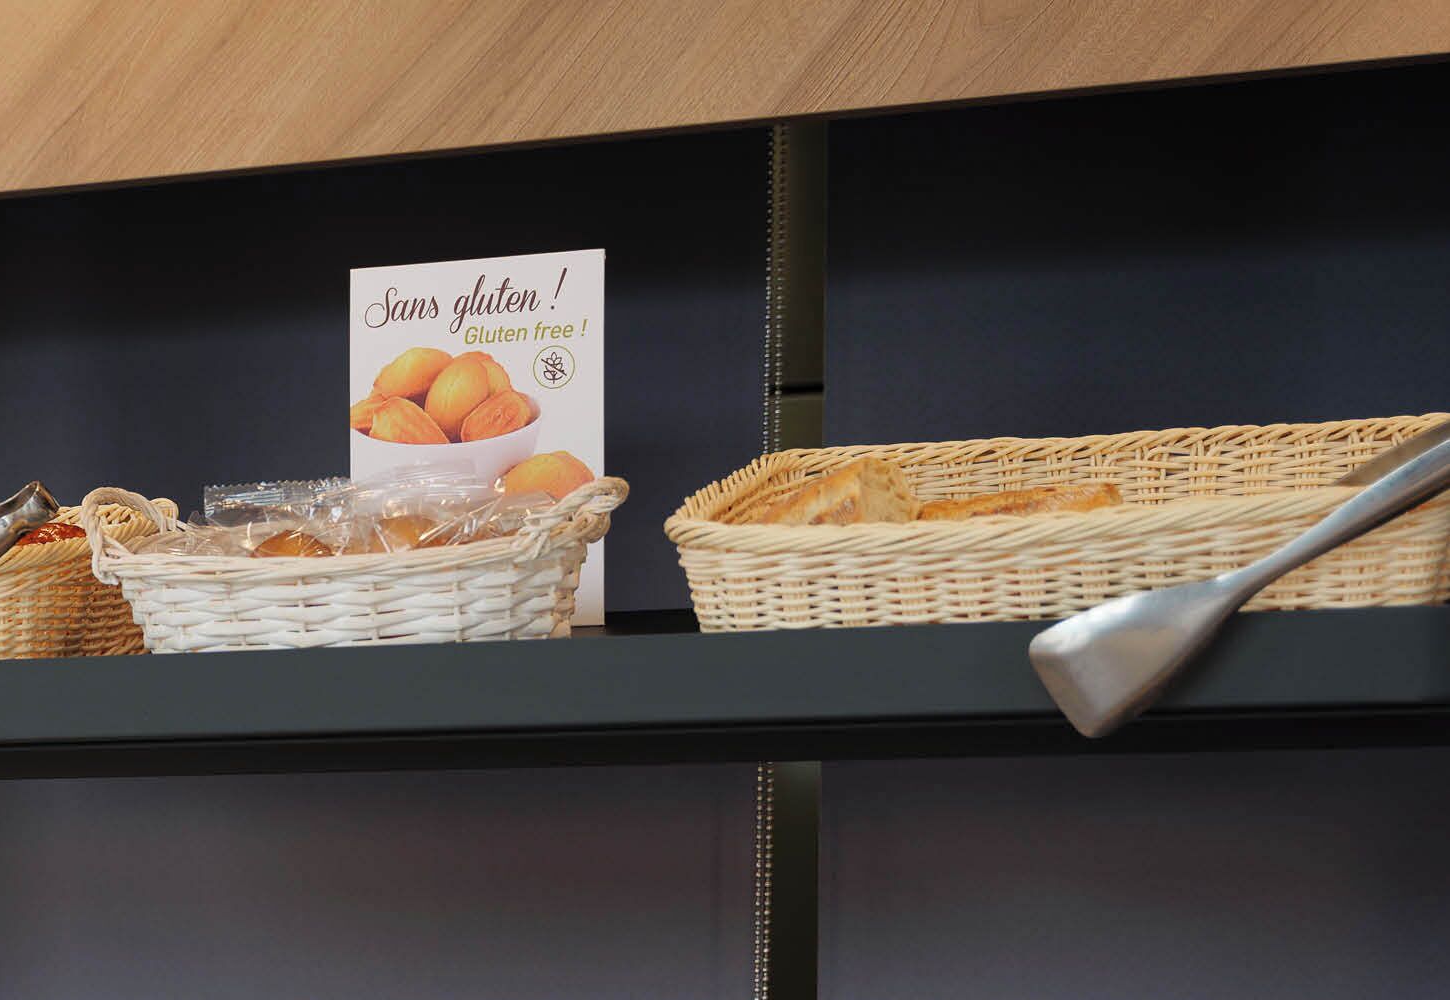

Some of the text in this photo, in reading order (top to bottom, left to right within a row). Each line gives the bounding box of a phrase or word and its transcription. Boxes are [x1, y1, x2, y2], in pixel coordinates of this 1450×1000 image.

[364, 267, 568, 334] Sans gluten !
[464, 318, 589, 345] Gluten free !
